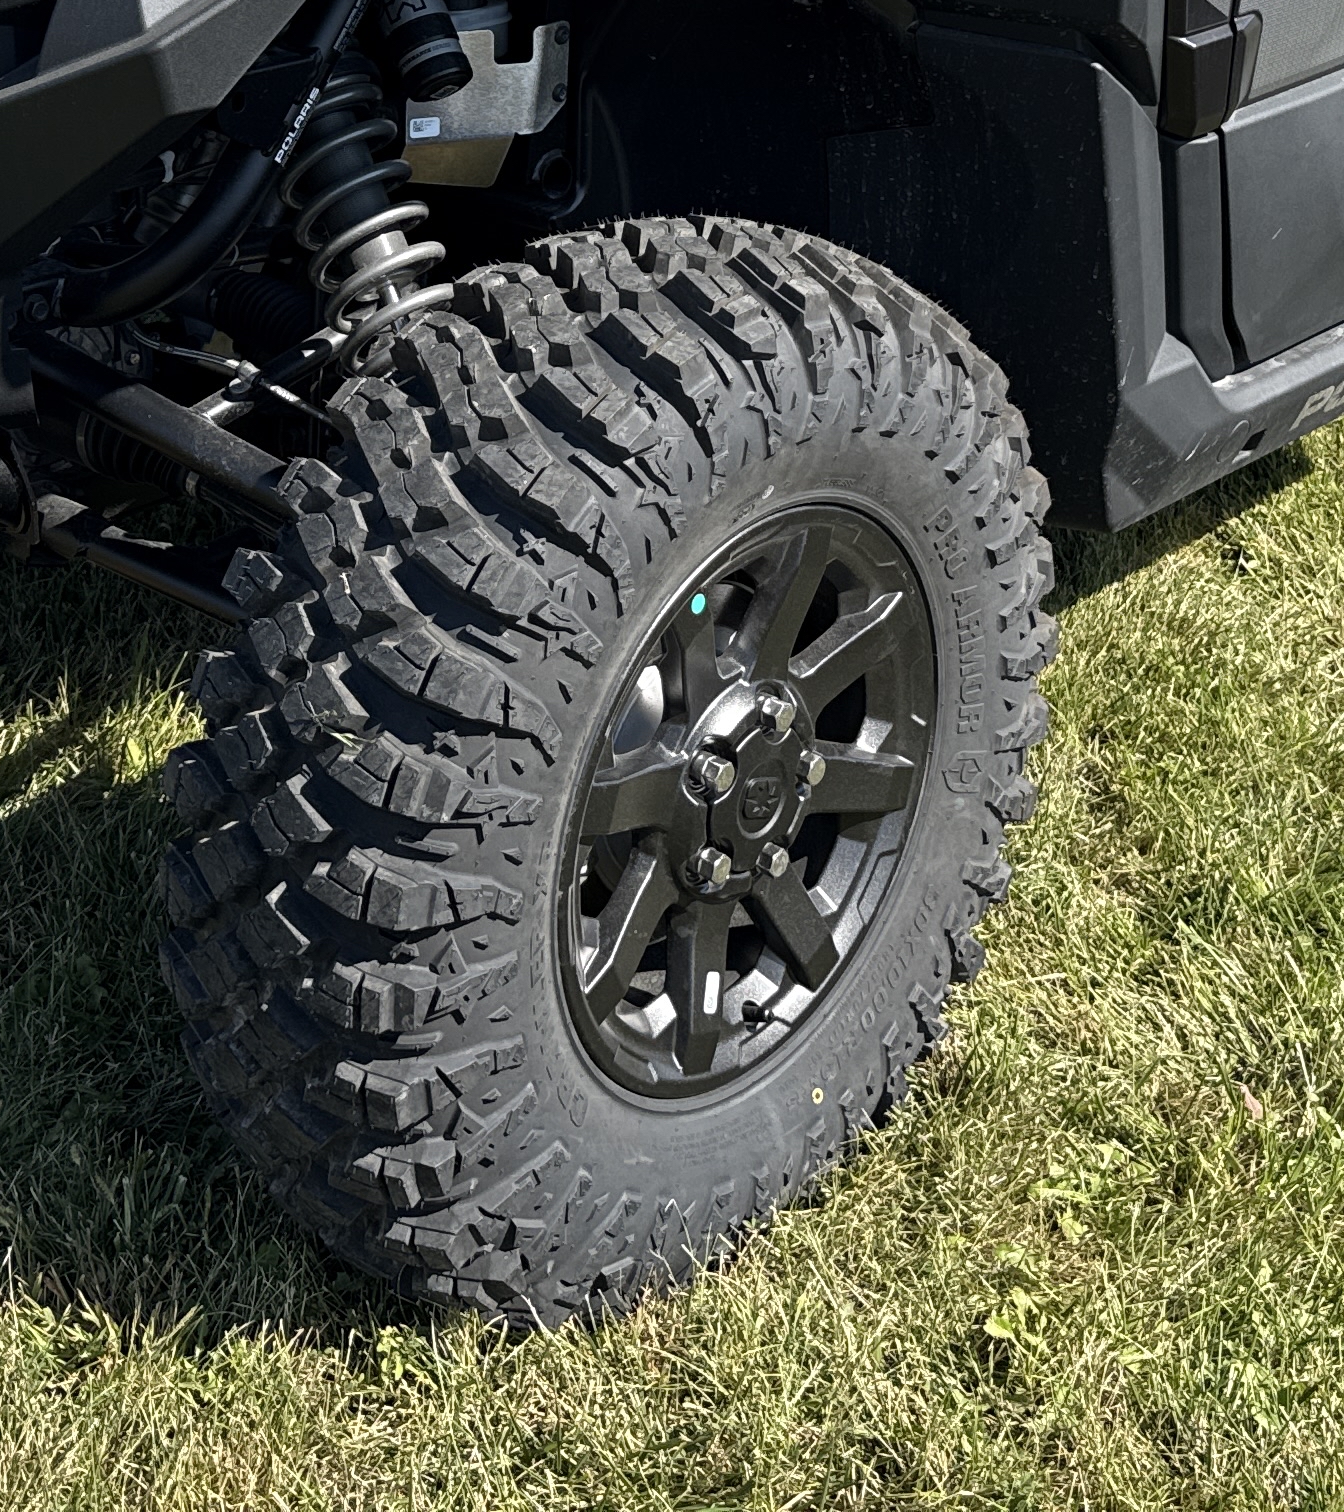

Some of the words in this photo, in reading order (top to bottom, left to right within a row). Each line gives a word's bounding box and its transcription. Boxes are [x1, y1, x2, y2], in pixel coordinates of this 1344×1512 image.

[274, 87, 320, 164] POLARIS
[922, 504, 969, 581] PRO
[952, 584, 987, 735] ARMOR
